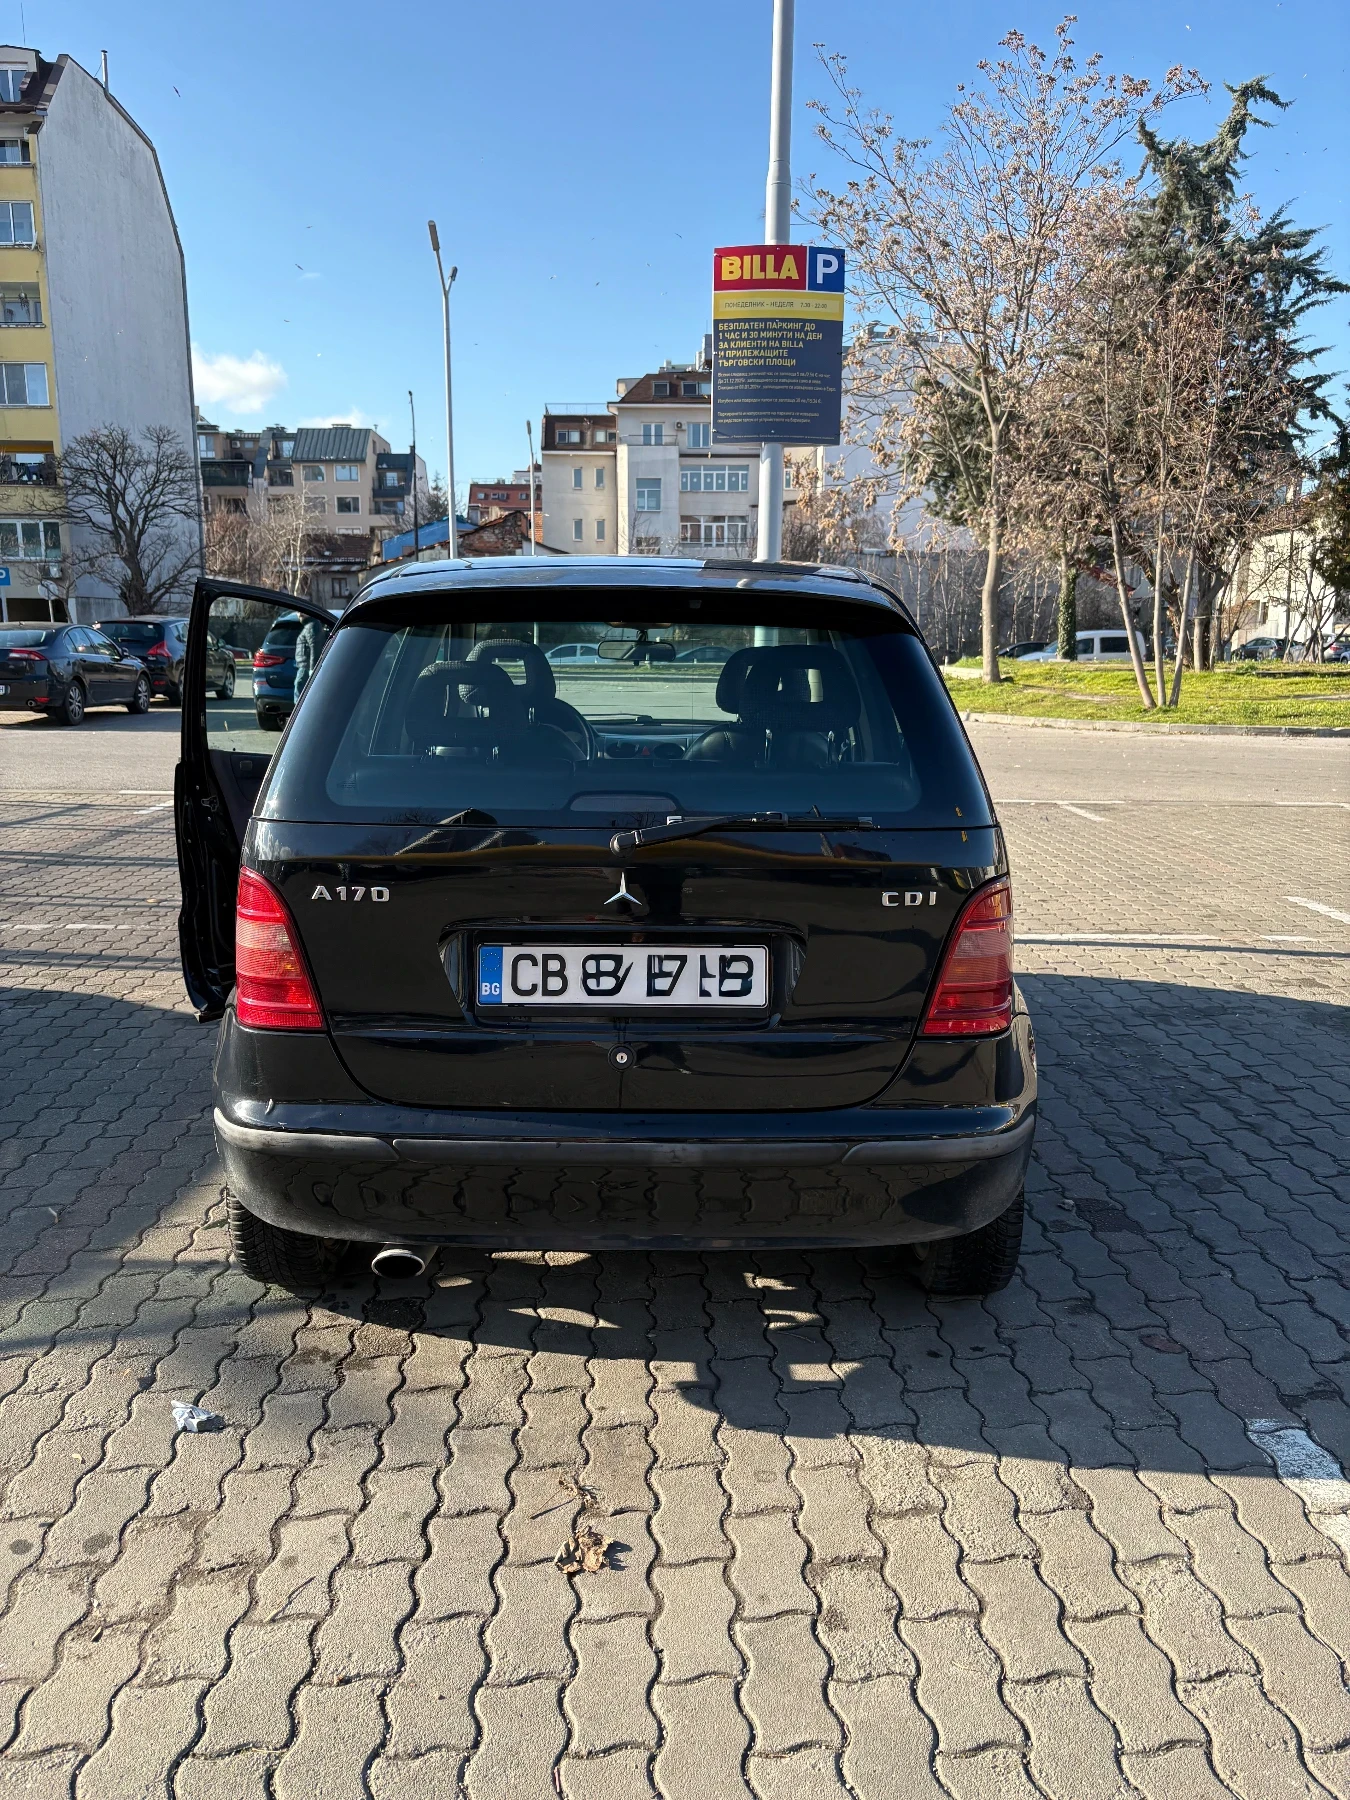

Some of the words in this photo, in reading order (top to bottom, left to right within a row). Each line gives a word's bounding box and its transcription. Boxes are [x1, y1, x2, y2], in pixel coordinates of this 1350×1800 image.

[721, 254, 799, 281] BILLA
[816, 253, 839, 284] P
[725, 301, 765, 309] ПОНЕДЕЛНИК
[718, 322, 765, 331] БЕЗПЛАТЕН
[766, 321, 802, 330] ПАРКИНГ
[804, 322, 816, 332] ДО
[724, 332, 740, 340] ЧАС
[761, 331, 793, 339] МИНУТИ
[795, 331, 805, 339] НА
[806, 332, 823, 341] ДЕН
[718, 341, 728, 349] ЗА
[730, 340, 767, 349] КЛИЕНТИ
[769, 340, 780, 348] НА
[781, 340, 804, 349] BILLA
[725, 349, 788, 358] ПРИЛЕЖАЩИТЕ
[718, 359, 764, 368] ТЪРГОВСКИ
[765, 358, 796, 368] ПЛОЩИ
[310, 885, 390, 902] A170
[881, 890, 937, 907] CDI
[481, 982, 500, 996] BG
